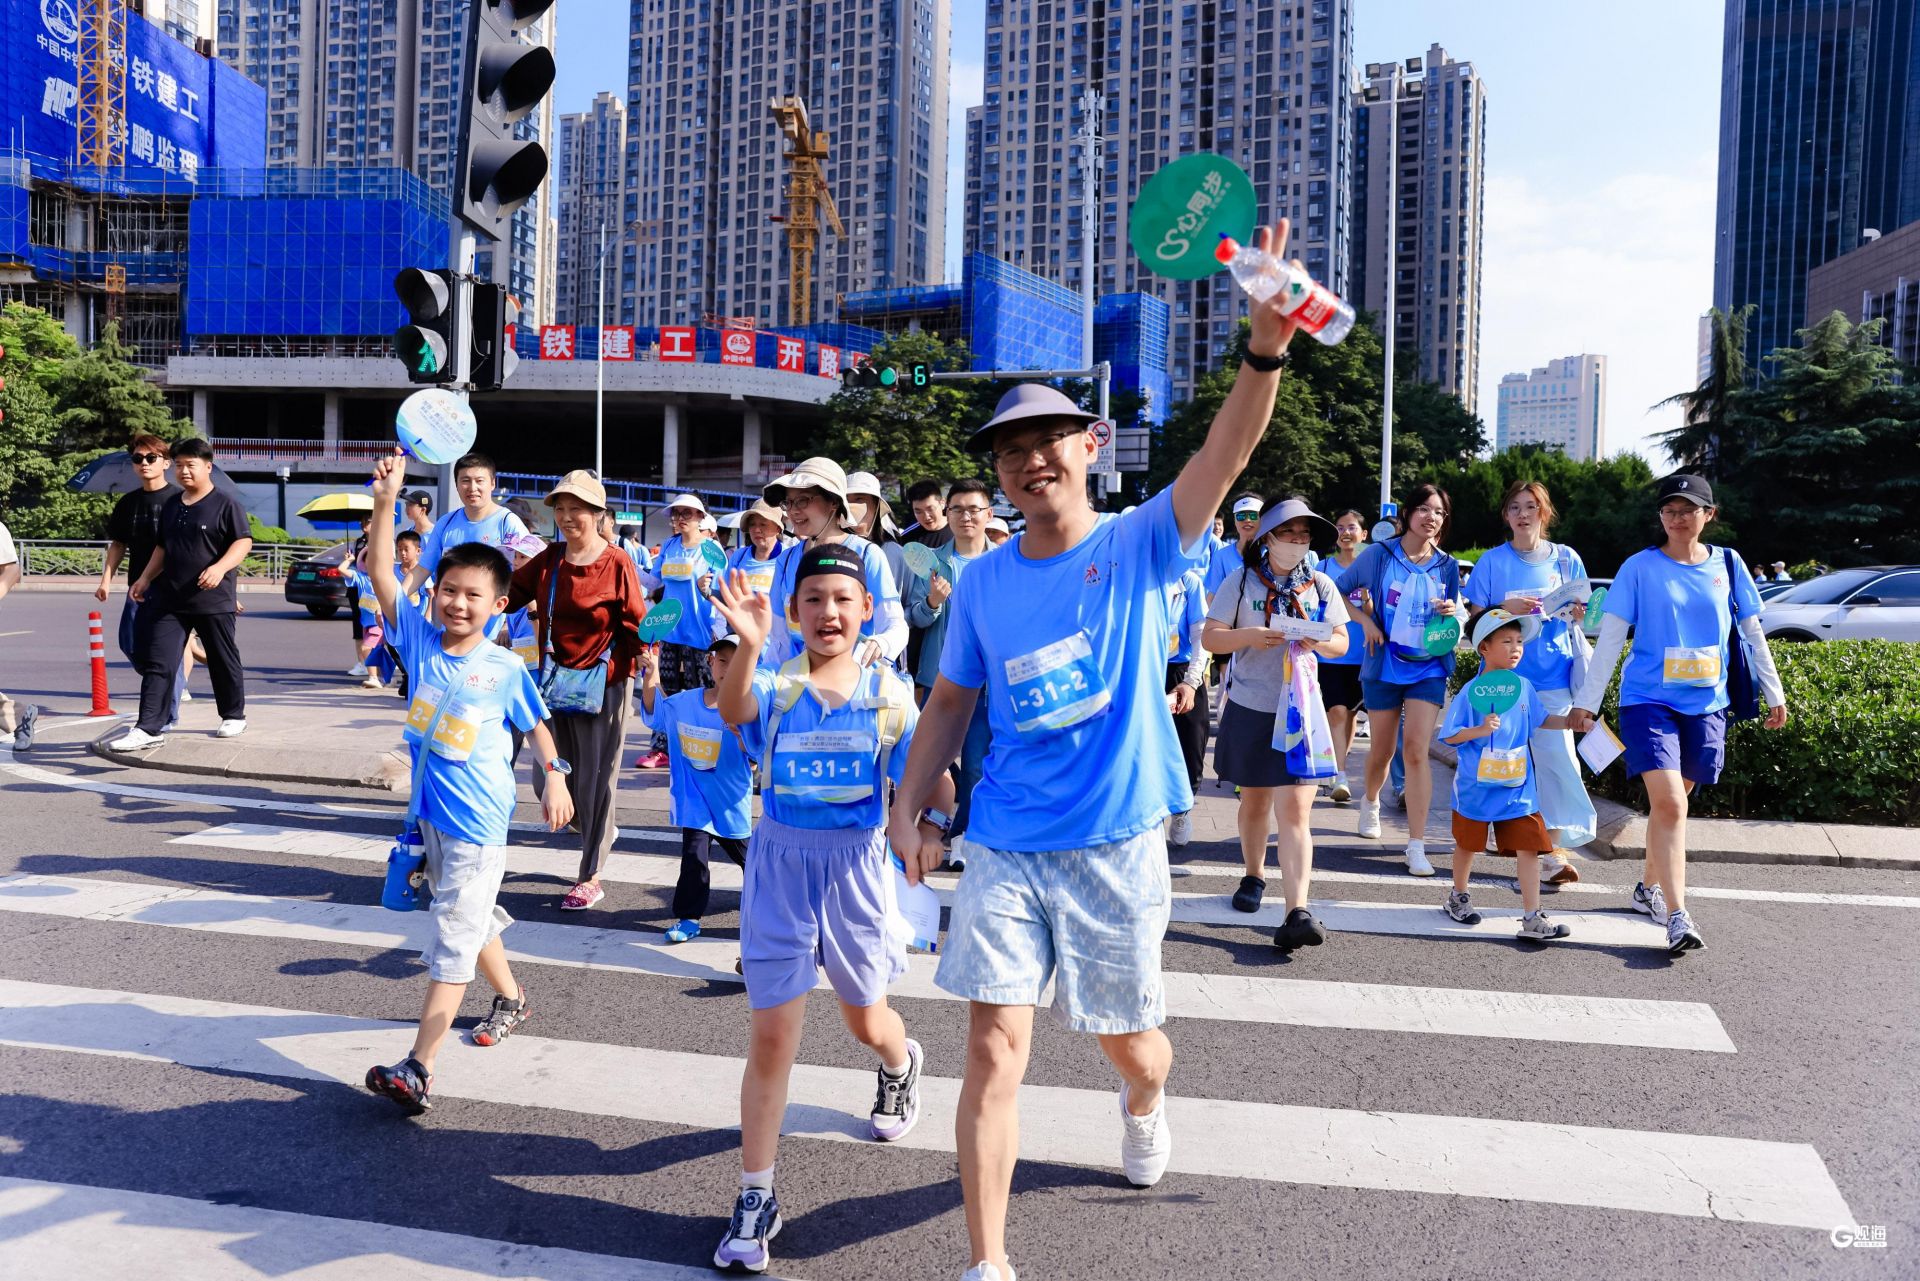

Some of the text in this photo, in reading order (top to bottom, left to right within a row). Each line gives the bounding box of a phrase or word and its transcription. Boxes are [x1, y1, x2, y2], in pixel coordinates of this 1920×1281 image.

[1177, 170, 1222, 234] 心同步
[914, 365, 926, 386] 6
[1009, 670, 1088, 714] 1-31-2
[786, 759, 861, 778] 1-31-1
